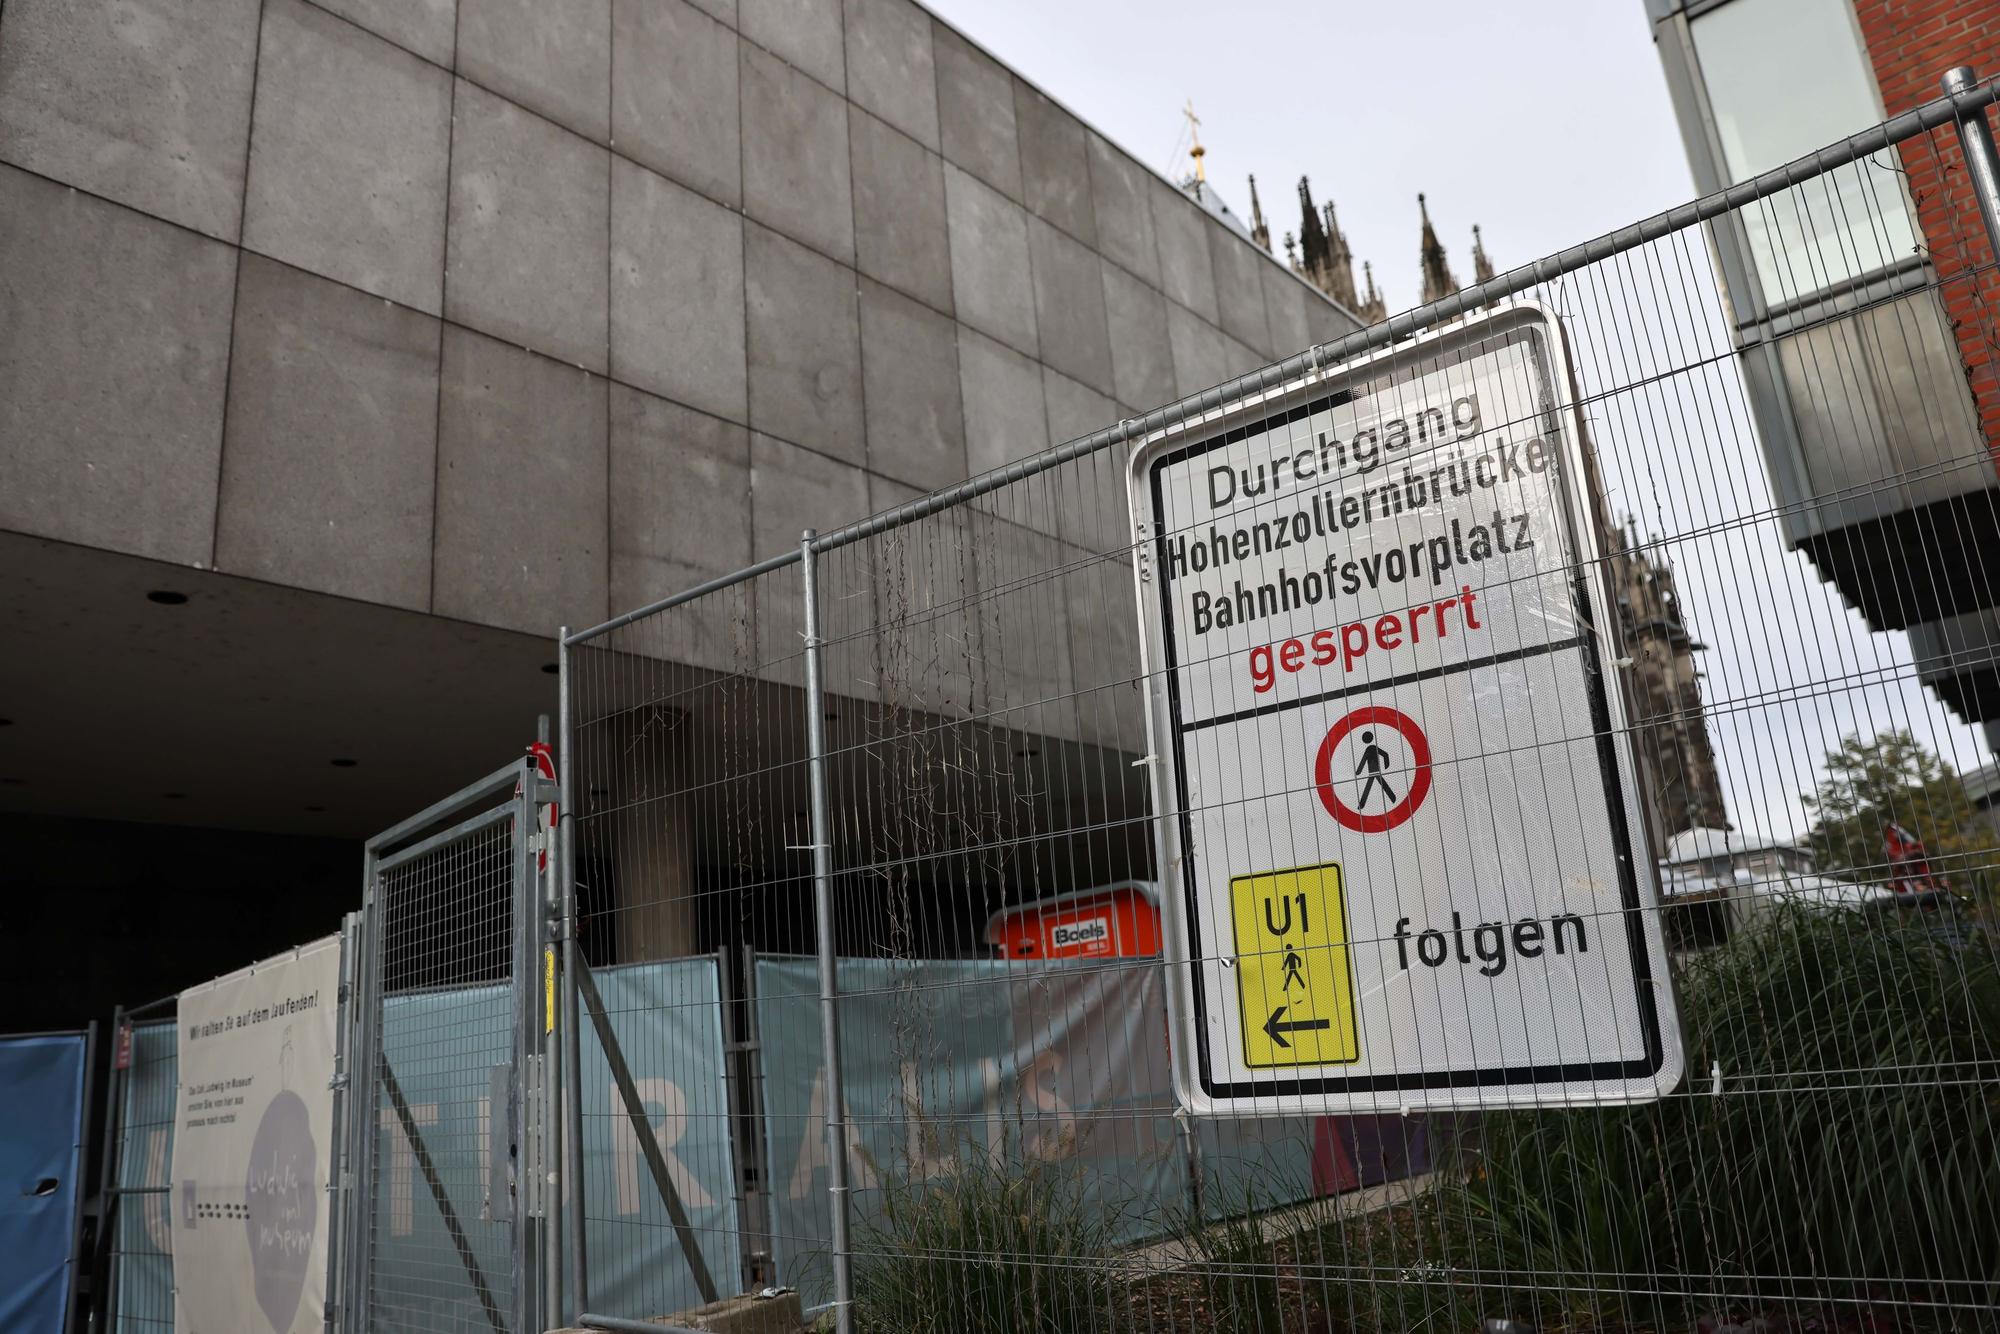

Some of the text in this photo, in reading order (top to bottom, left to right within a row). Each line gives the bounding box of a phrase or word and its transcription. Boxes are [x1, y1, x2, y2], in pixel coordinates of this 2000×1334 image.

[1208, 392, 1482, 511] Durchgang
[1166, 436, 1551, 581] Hohenzollernbrücke
[1192, 512, 1535, 636] Bahnhofsvorplatz
[1248, 583, 1482, 694] gesperrt
[1054, 923, 1105, 945] Boels
[1263, 892, 1311, 937] U1
[1393, 910, 1589, 978] folgen
